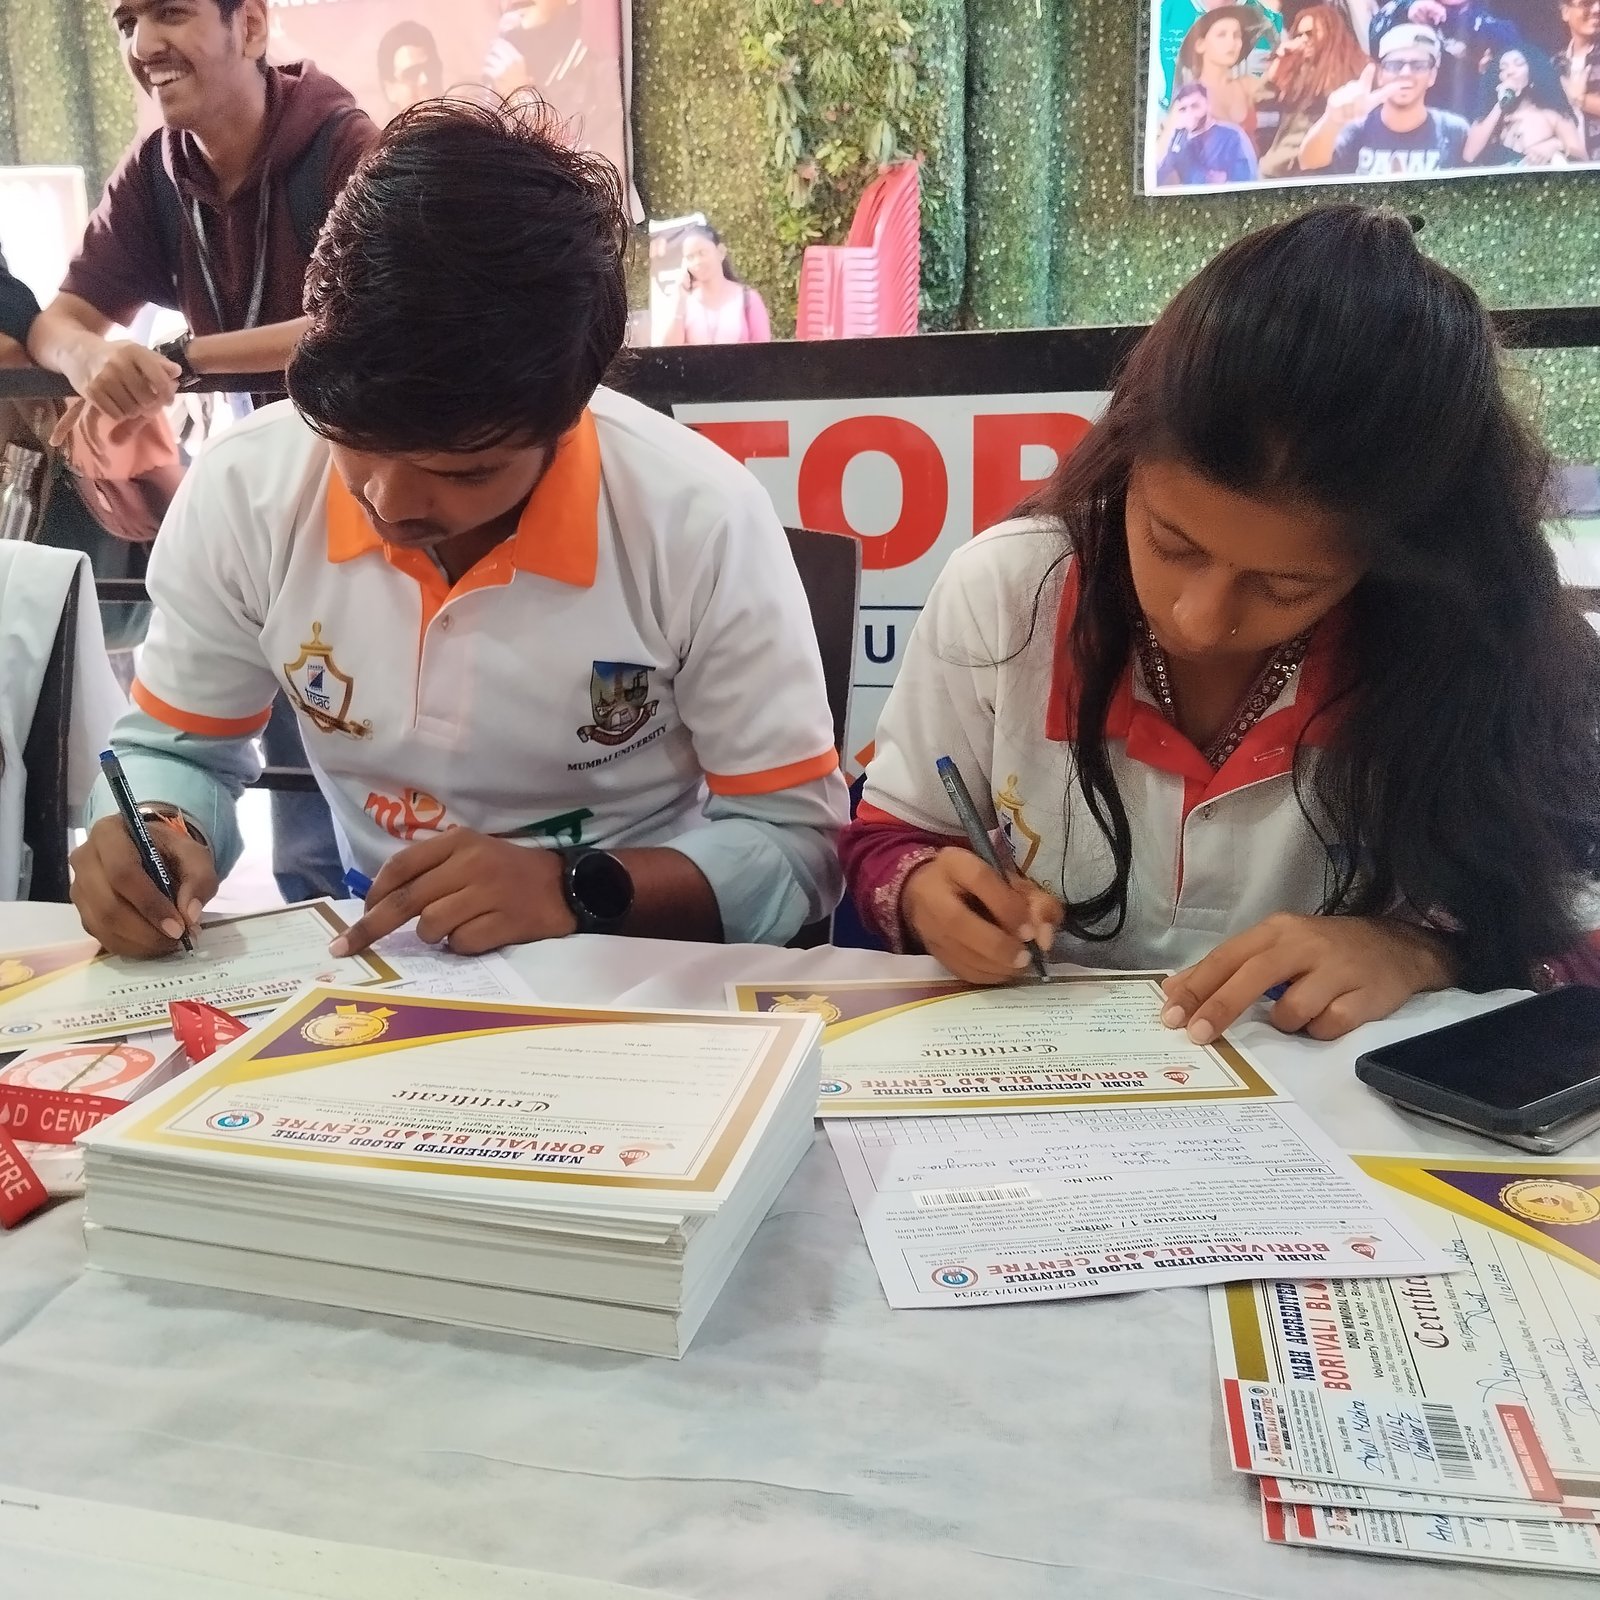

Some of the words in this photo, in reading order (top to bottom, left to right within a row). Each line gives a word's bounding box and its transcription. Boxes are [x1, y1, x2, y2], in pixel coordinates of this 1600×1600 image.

[567, 754, 613, 771] MUMBAI
[614, 724, 668, 760] UNIVERSITY
[919, 1044, 1058, 1058] Certificate
[859, 1079, 947, 1088] CENTRE
[1044, 1071, 1149, 1083] BORIVALI
[1099, 1080, 1145, 1088] NABH
[871, 1087, 934, 1096] CENTRE
[941, 1086, 991, 1095] BLOOD
[998, 1082, 1092, 1093] ACCREDITED
[391, 1089, 550, 1113] Certificate
[40, 1107, 112, 1132] CENT
[270, 1117, 372, 1137] CENTRE
[270, 1129, 342, 1144] CENTRE
[348, 1137, 406, 1151] BLOOD
[480, 1136, 605, 1156] BORIVALI
[412, 1143, 525, 1161] ACCREDITED
[531, 1152, 586, 1165] NABH
[1273, 1166, 1327, 1175] Voluntary
[1085, 1174, 1114, 1184] Unit
[1143, 1214, 1218, 1225] Annexure
[1206, 1242, 1331, 1254] BORIVALI
[1152, 1253, 1265, 1269] ACCREDITED
[1274, 1253, 1328, 1262] NABH
[985, 1257, 1091, 1276] CENTRE
[1085, 1262, 1145, 1275] BLOOD
[1002, 1270, 1077, 1284] CENTRE
[1275, 1282, 1309, 1346] ACCREDITED
[1355, 1302, 1370, 1320] Night
[1362, 1328, 1375, 1342] Day
[1309, 1318, 1353, 1391] BORIVALI
[1288, 1349, 1317, 1382] NABH
